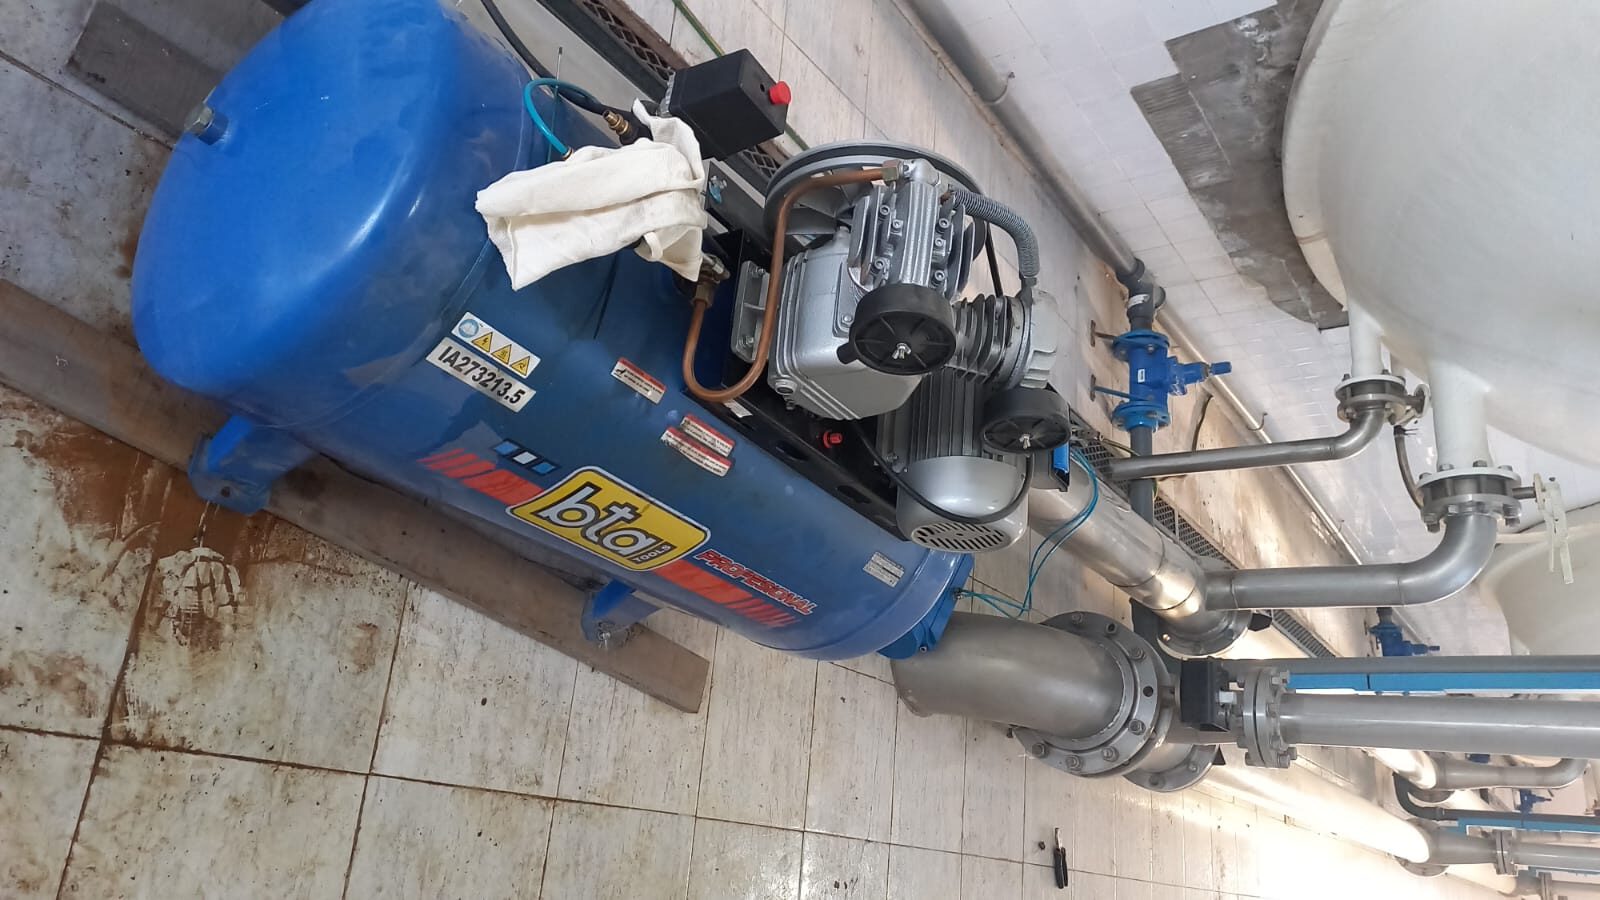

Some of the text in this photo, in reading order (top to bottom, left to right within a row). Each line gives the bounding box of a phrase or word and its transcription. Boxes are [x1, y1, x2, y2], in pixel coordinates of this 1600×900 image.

[437, 345, 526, 405] IA273213.5
[533, 482, 662, 557] bta
[632, 543, 674, 563] TOOLS
[694, 549, 817, 615] PROFESIONAL
